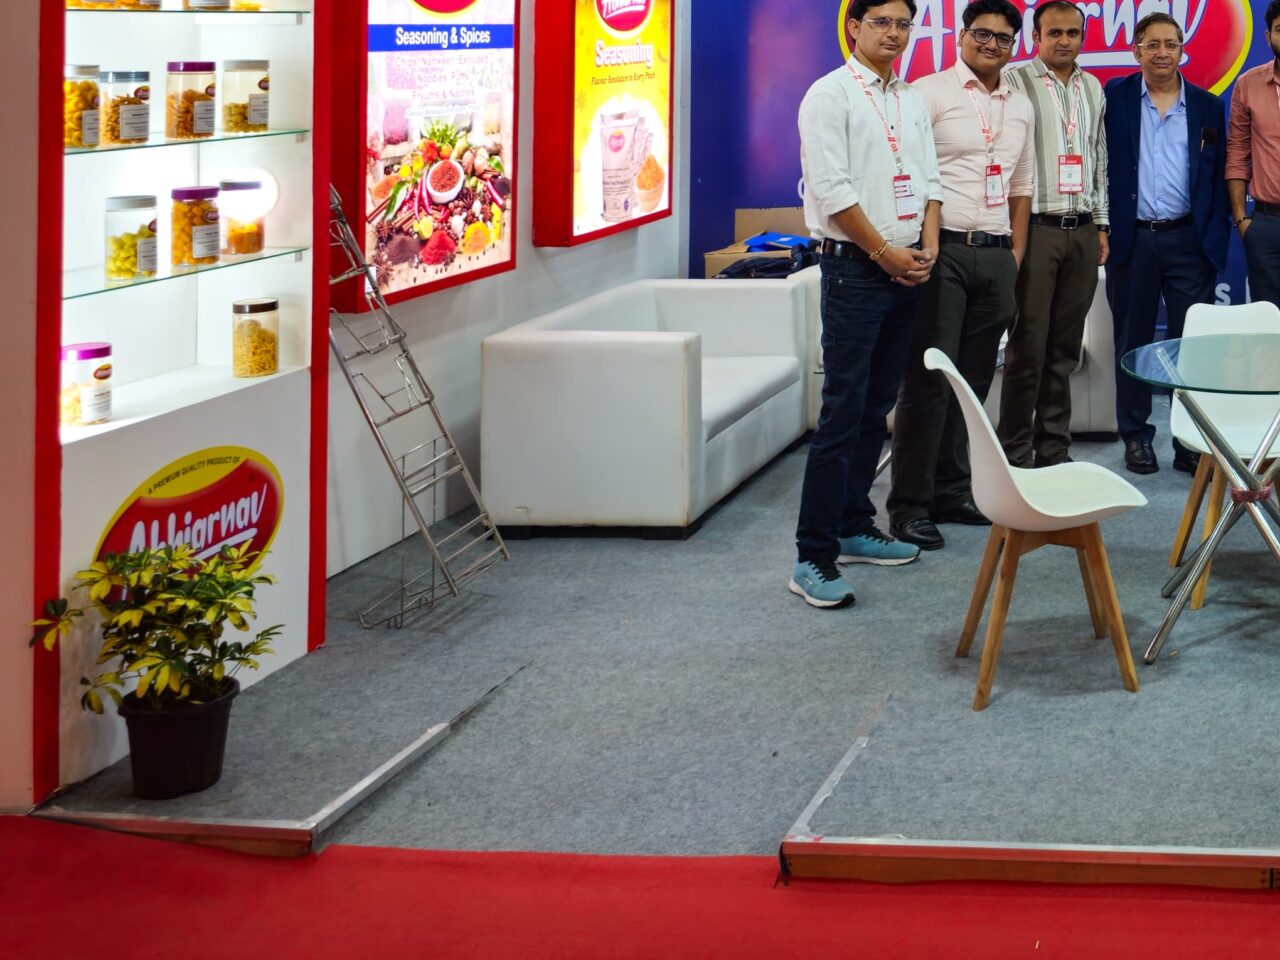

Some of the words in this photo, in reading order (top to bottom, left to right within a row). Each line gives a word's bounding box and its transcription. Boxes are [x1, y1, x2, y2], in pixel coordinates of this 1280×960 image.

[396, 27, 448, 48] Seasoning
[451, 27, 458, 45] &
[460, 26, 490, 48] Spices
[595, 39, 654, 69] Seasoning
[154, 468, 181, 490] PREMIUM
[182, 460, 206, 476] QUALITY
[206, 455, 232, 466] PRODUCT
